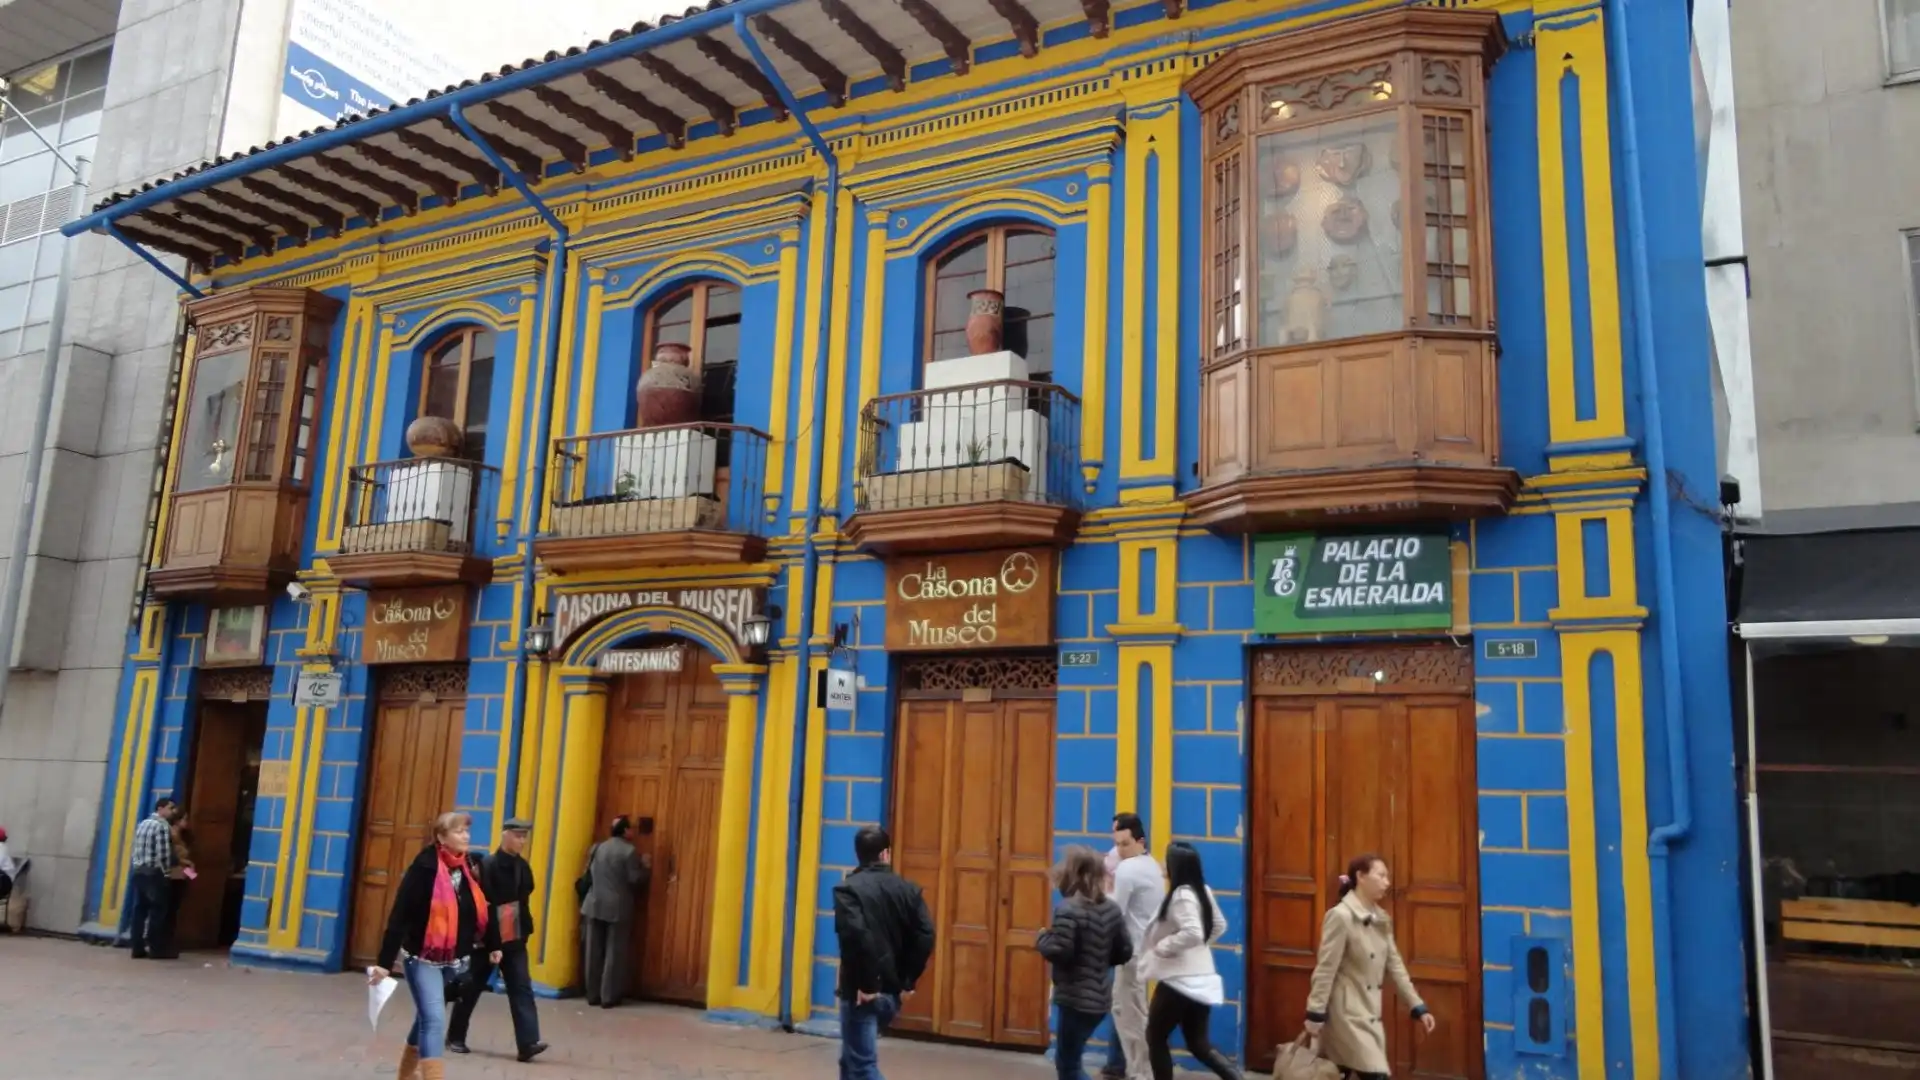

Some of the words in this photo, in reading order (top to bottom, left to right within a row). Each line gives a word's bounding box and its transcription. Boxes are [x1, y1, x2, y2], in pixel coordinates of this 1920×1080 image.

[1322, 537, 1420, 563] PALACIO
[927, 561, 947, 580] La
[1338, 563, 1370, 584] DE
[1376, 561, 1406, 582] LA
[899, 573, 997, 601] Casona
[1304, 581, 1444, 609] ESMERALDA
[373, 603, 431, 624] Casona
[554, 592, 632, 649] CASONA
[637, 591, 675, 606] DEL
[680, 587, 753, 646] MUSEO
[963, 603, 997, 624] del
[908, 619, 997, 646] Museo
[1069, 653, 1091, 664] 5-22
[1497, 642, 1525, 655] 5-18
[601, 650, 681, 672] ARTESANIAS
